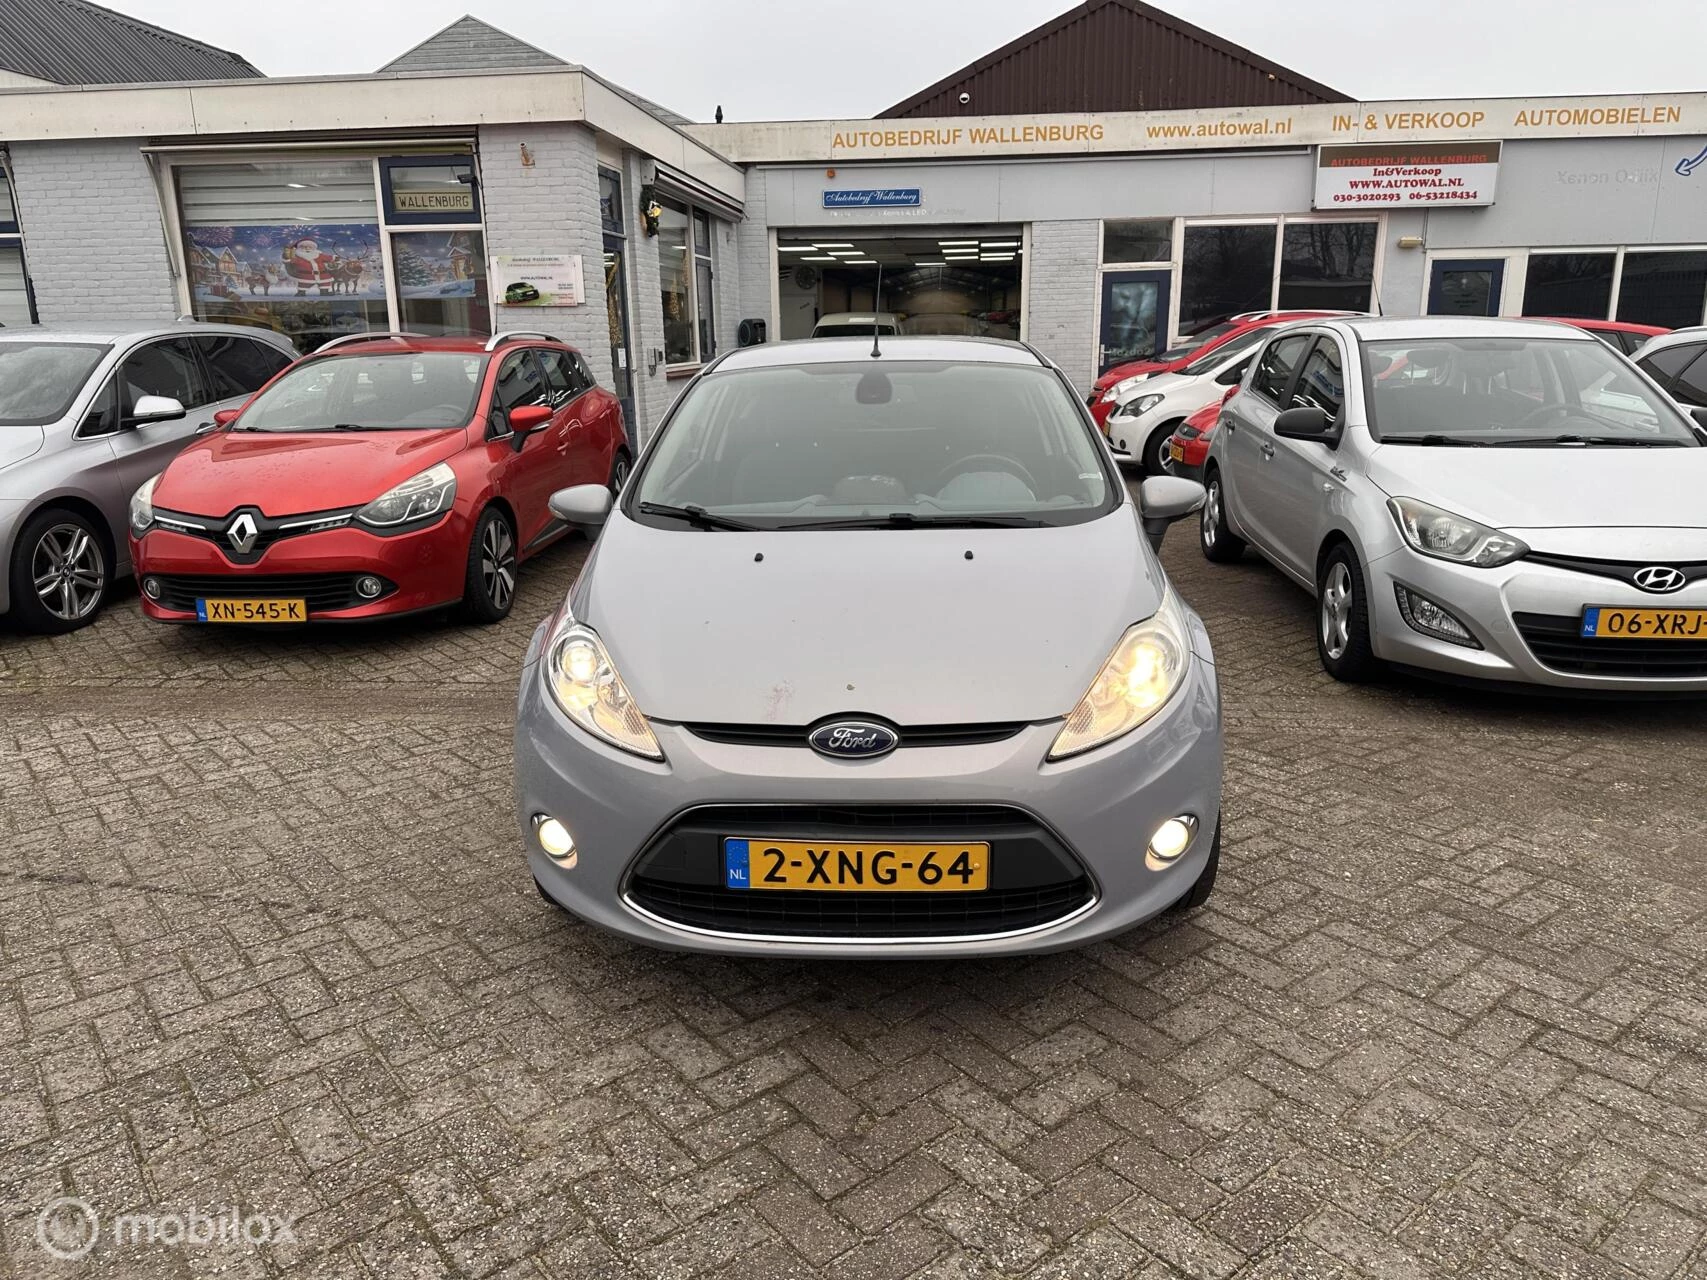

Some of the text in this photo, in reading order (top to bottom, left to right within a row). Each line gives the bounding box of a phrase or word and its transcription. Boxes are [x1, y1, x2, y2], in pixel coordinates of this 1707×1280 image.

[1331, 111, 1485, 131] IN- & VERKOOP
[1514, 106, 1681, 126] AUTOMOBIELEN
[1146, 117, 1292, 138] www.autowal.nl
[832, 124, 1104, 149] AUTOBEDRIJF WALLENBURG
[1330, 154, 1488, 167] AUTOBEDRIJF WALLENBURG
[1349, 178, 1465, 189] WWW.AUTOWAL.NL
[398, 195, 469, 208] WALLENBURG
[825, 189, 917, 204] Autobedrijf Wallenburg
[1333, 190, 1478, 202] 030-3020293 06-53218434
[210, 602, 300, 619] XN-545-K
[1584, 624, 1595, 632] NL
[828, 727, 877, 748] Ford
[729, 868, 746, 880] NL
[763, 847, 974, 886] 2-XNG-64
